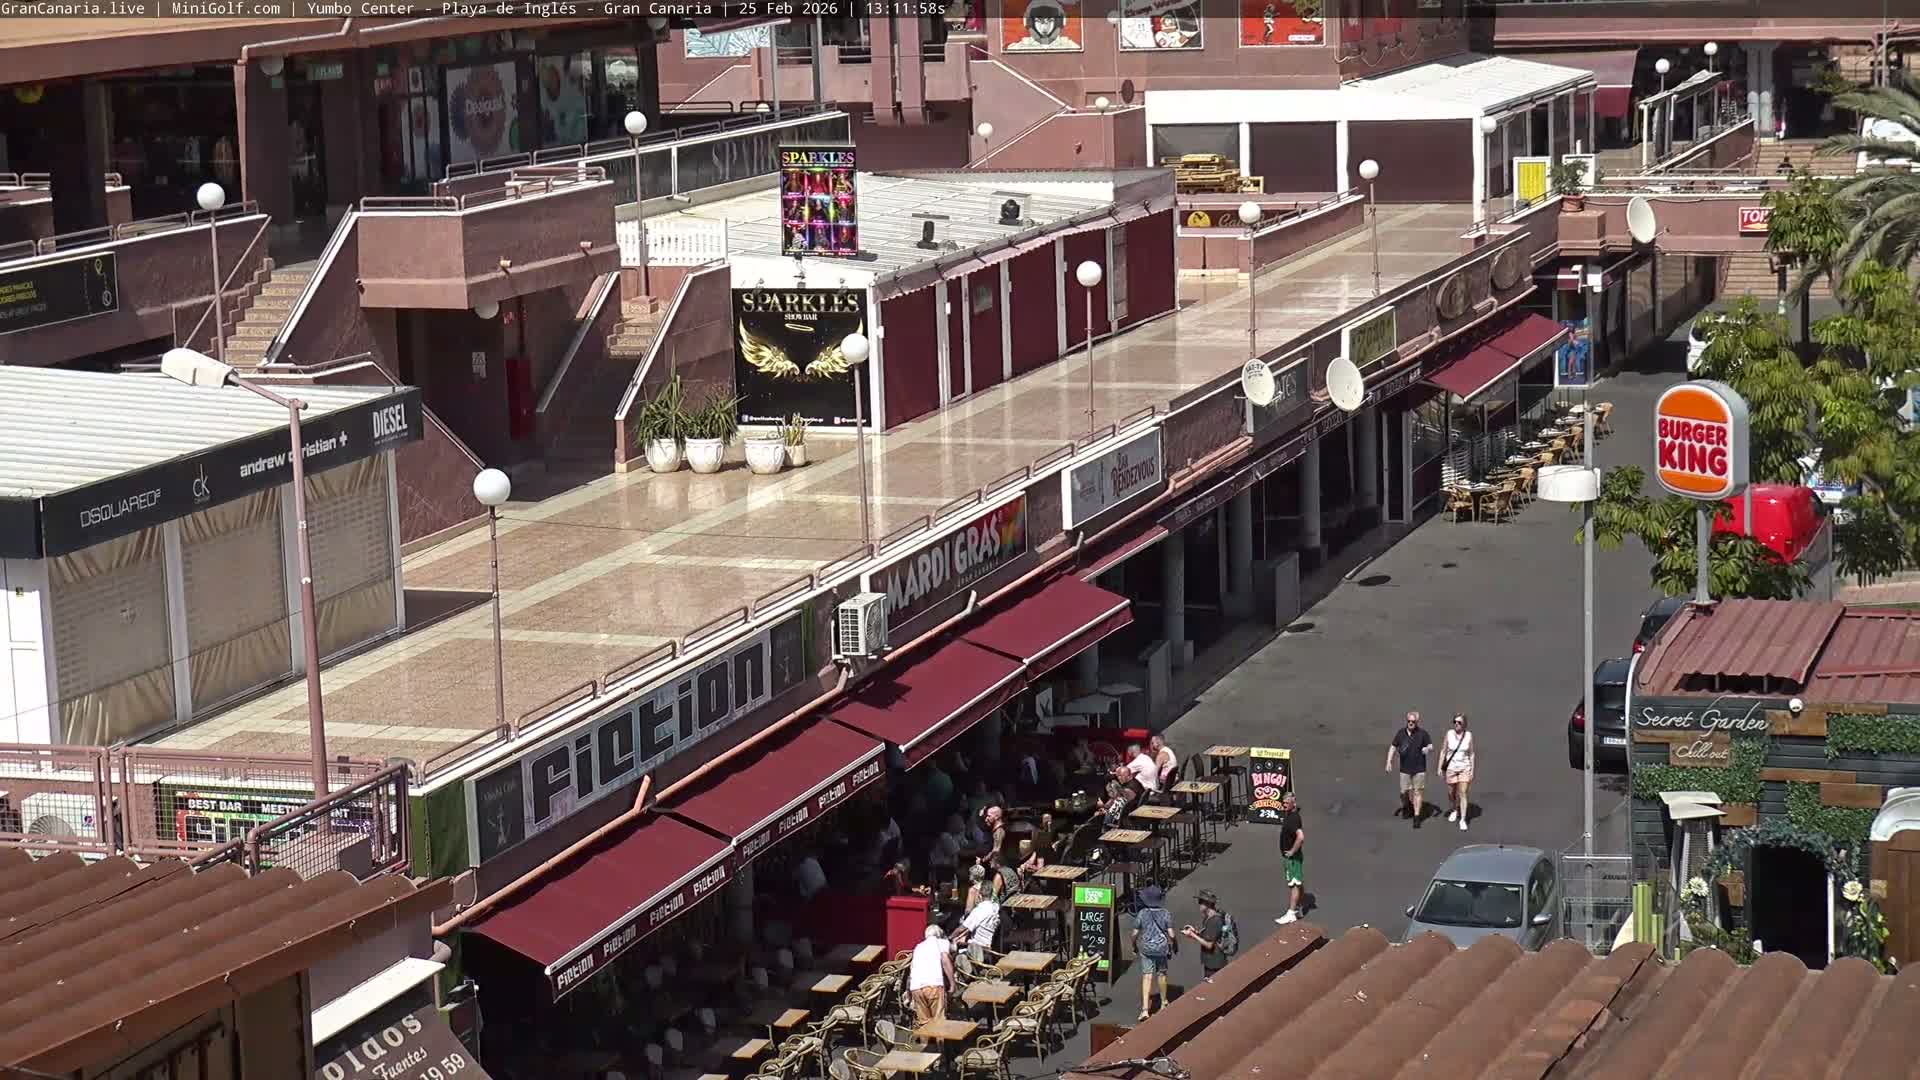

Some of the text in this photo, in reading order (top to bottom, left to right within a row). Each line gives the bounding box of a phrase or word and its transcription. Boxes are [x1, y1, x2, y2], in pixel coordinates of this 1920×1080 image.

[782, 151, 855, 164] SPARKLES
[742, 292, 860, 313] SPARKLES
[784, 313, 818, 321] SHOW BAR
[372, 403, 408, 438] DIESEL
[1658, 418, 1728, 447] BURGER
[240, 436, 337, 478] andrew cristian
[1658, 439, 1728, 476] KING
[192, 463, 210, 498] ck
[1111, 456, 1156, 497] RENDEZVOUS
[887, 541, 950, 615] MARDI
[954, 513, 1001, 574] GRAS
[1636, 697, 1770, 738] Secret Garden
[1676, 741, 1730, 759] Chill out
[1251, 772, 1287, 787] BINGO!
[188, 800, 217, 811] BEST
[219, 801, 242, 812] BAR
[262, 803, 308, 815] MEETI
[1080, 912, 1104, 922] LARGE
[1081, 922, 1102, 933] BEER
[323, 1013, 422, 1080] oldos
[372, 1046, 428, 1080] Fuentes
